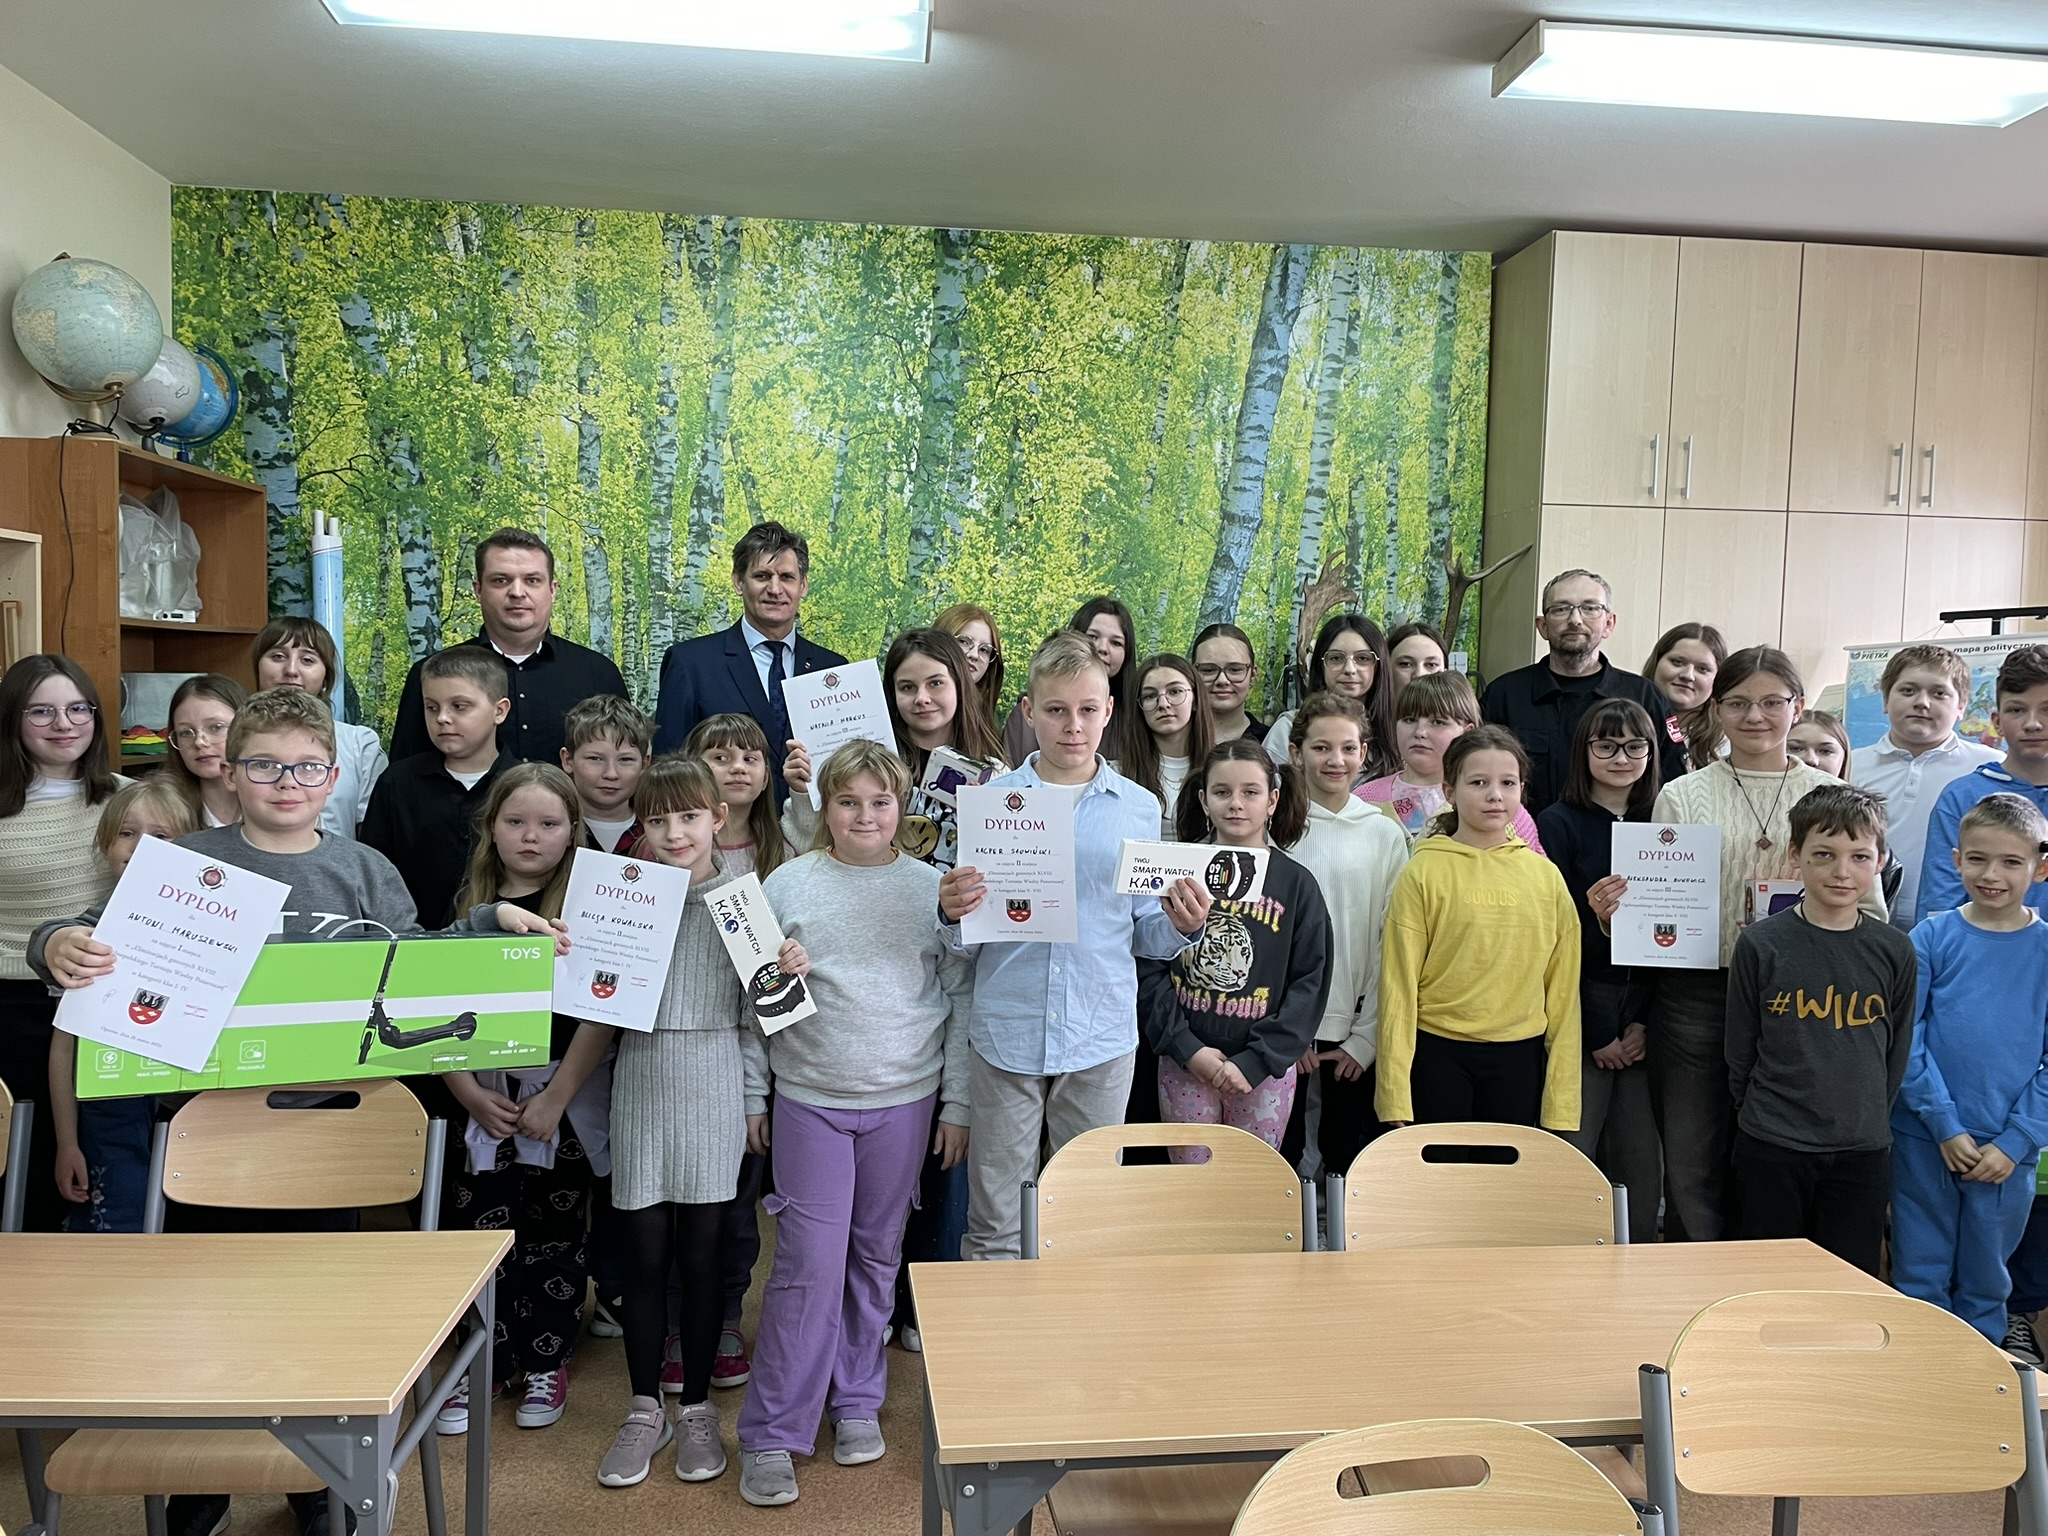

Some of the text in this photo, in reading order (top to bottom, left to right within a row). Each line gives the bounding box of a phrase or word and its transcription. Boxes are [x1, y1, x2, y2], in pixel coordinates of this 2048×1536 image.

[1953, 646, 1981, 654] mapa
[810, 690, 861, 709] DYPLOM
[985, 818, 1045, 831] DYPLOM
[1639, 850, 1694, 862] DYPLOM
[1132, 866, 1195, 877] SMART WATCH
[1209, 863, 1221, 874] 09
[1208, 874, 1219, 884] 15
[595, 884, 655, 906] DYPLOM
[1463, 887, 1517, 907] JOYOUS
[158, 884, 237, 922] DYPLOM
[611, 917, 653, 930] KOWALSKA
[730, 894, 762, 955] SMART WATCH
[128, 912, 238, 953] ANTONI MARUSZEWSKI
[501, 947, 541, 960] TOYS
[757, 970, 771, 983] 15
[767, 964, 780, 976] 09
[1767, 984, 1886, 1030] #WILD
